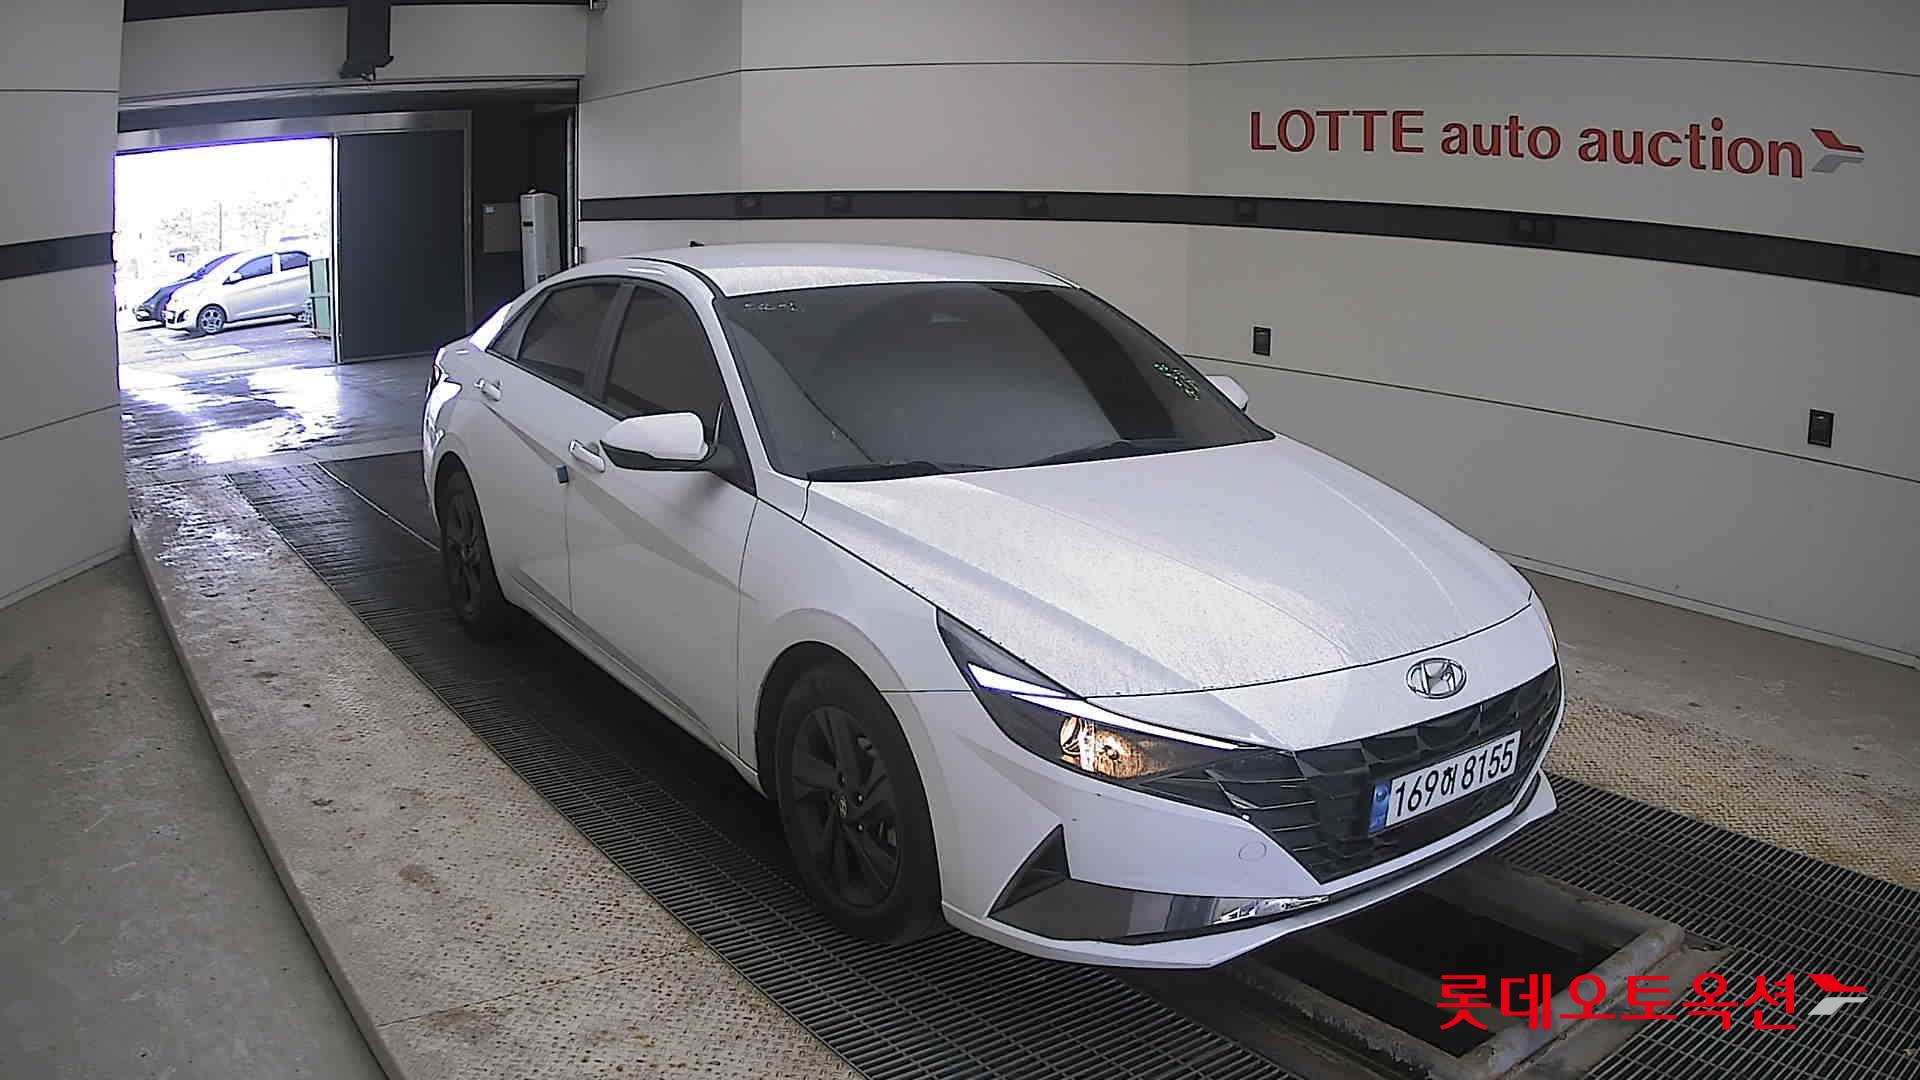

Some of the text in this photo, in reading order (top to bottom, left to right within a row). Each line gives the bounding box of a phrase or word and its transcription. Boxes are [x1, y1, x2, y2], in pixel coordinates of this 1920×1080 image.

[1250, 110, 1804, 178] LOTTE auto auction
[1395, 738, 1515, 817] 169허 8155
